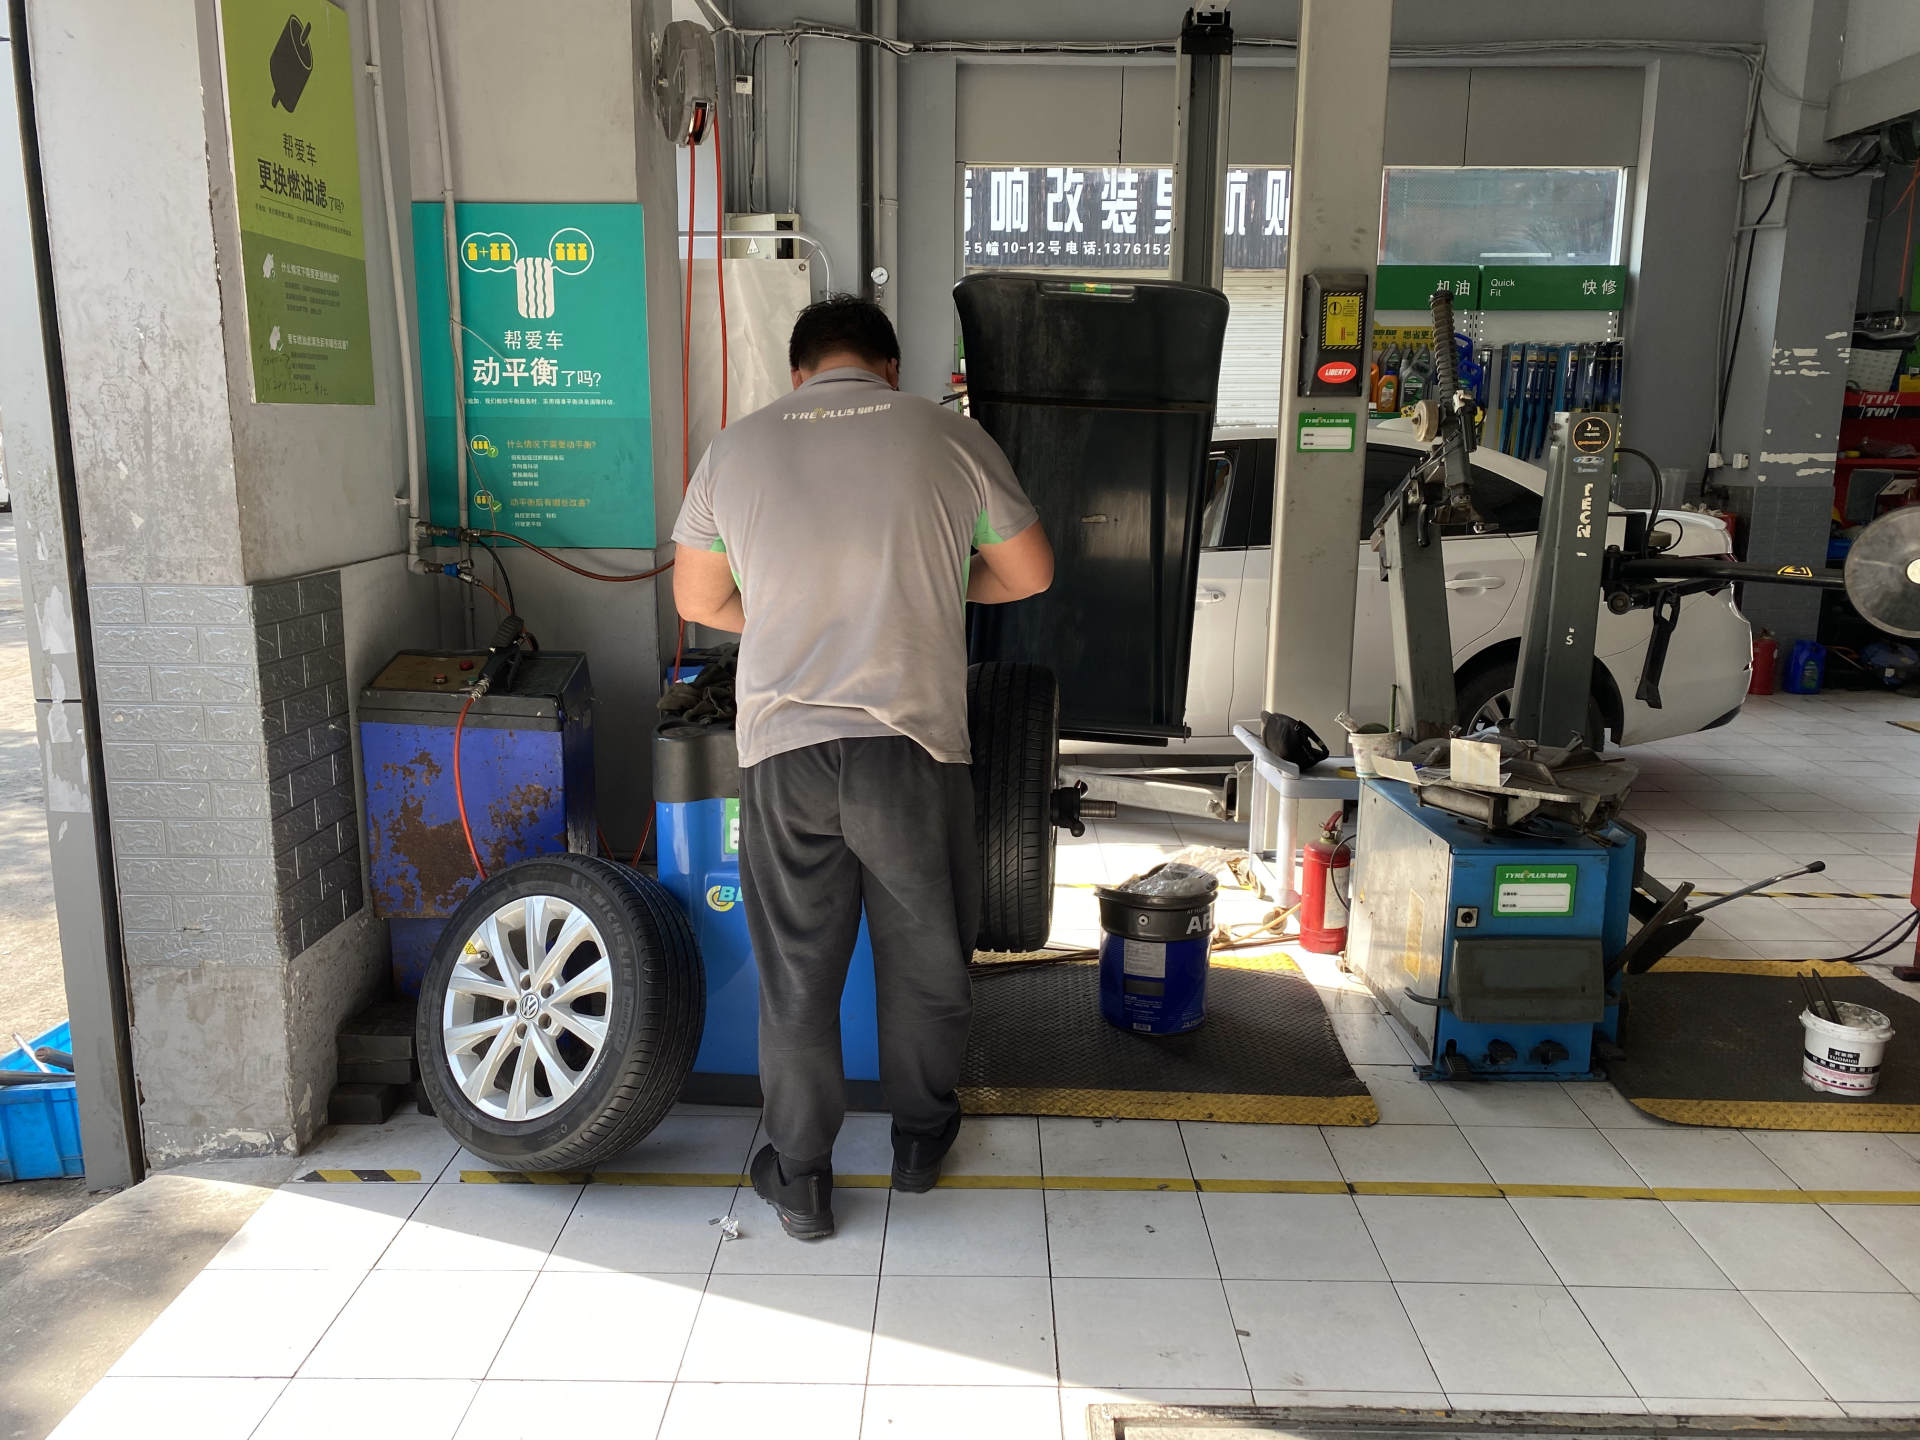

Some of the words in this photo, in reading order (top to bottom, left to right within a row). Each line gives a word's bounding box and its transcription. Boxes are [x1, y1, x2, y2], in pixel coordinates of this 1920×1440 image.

[283, 133, 317, 167] 帮爱车
[1437, 279, 1470, 296] 机油
[1490, 278, 1516, 288] Quick
[1582, 279, 1618, 296] 快修
[1490, 288, 1502, 297] Fit
[503, 330, 564, 351] 帮爱车
[472, 356, 602, 388] 动平衡了吗?
[1324, 368, 1352, 377] LIBERTY
[1866, 394, 1895, 404] TIP
[1866, 407, 1895, 417] TOP
